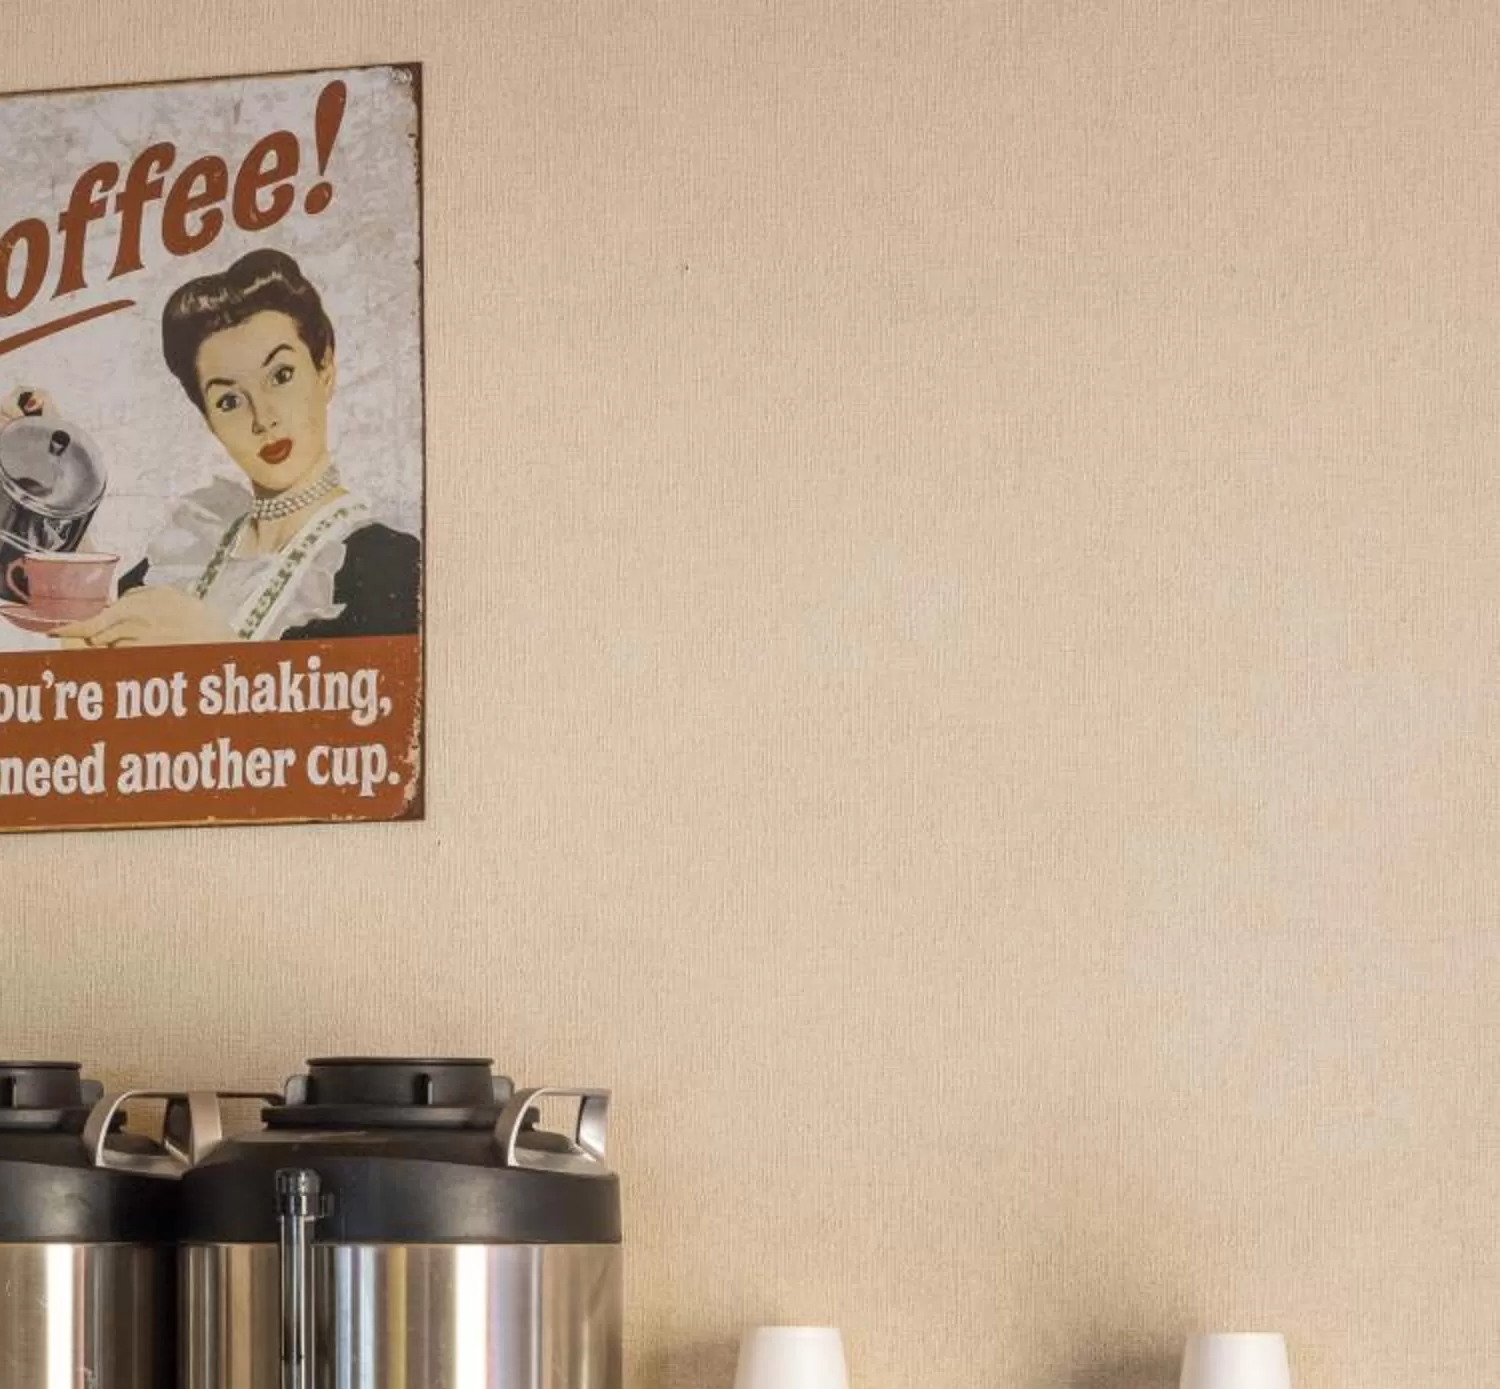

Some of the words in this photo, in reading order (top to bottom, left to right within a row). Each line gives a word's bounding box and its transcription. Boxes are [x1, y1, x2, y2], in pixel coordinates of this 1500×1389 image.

[115, 671, 188, 719] not
[199, 655, 393, 727] shaking,
[117, 737, 297, 796] another
[306, 743, 401, 798] cup.
